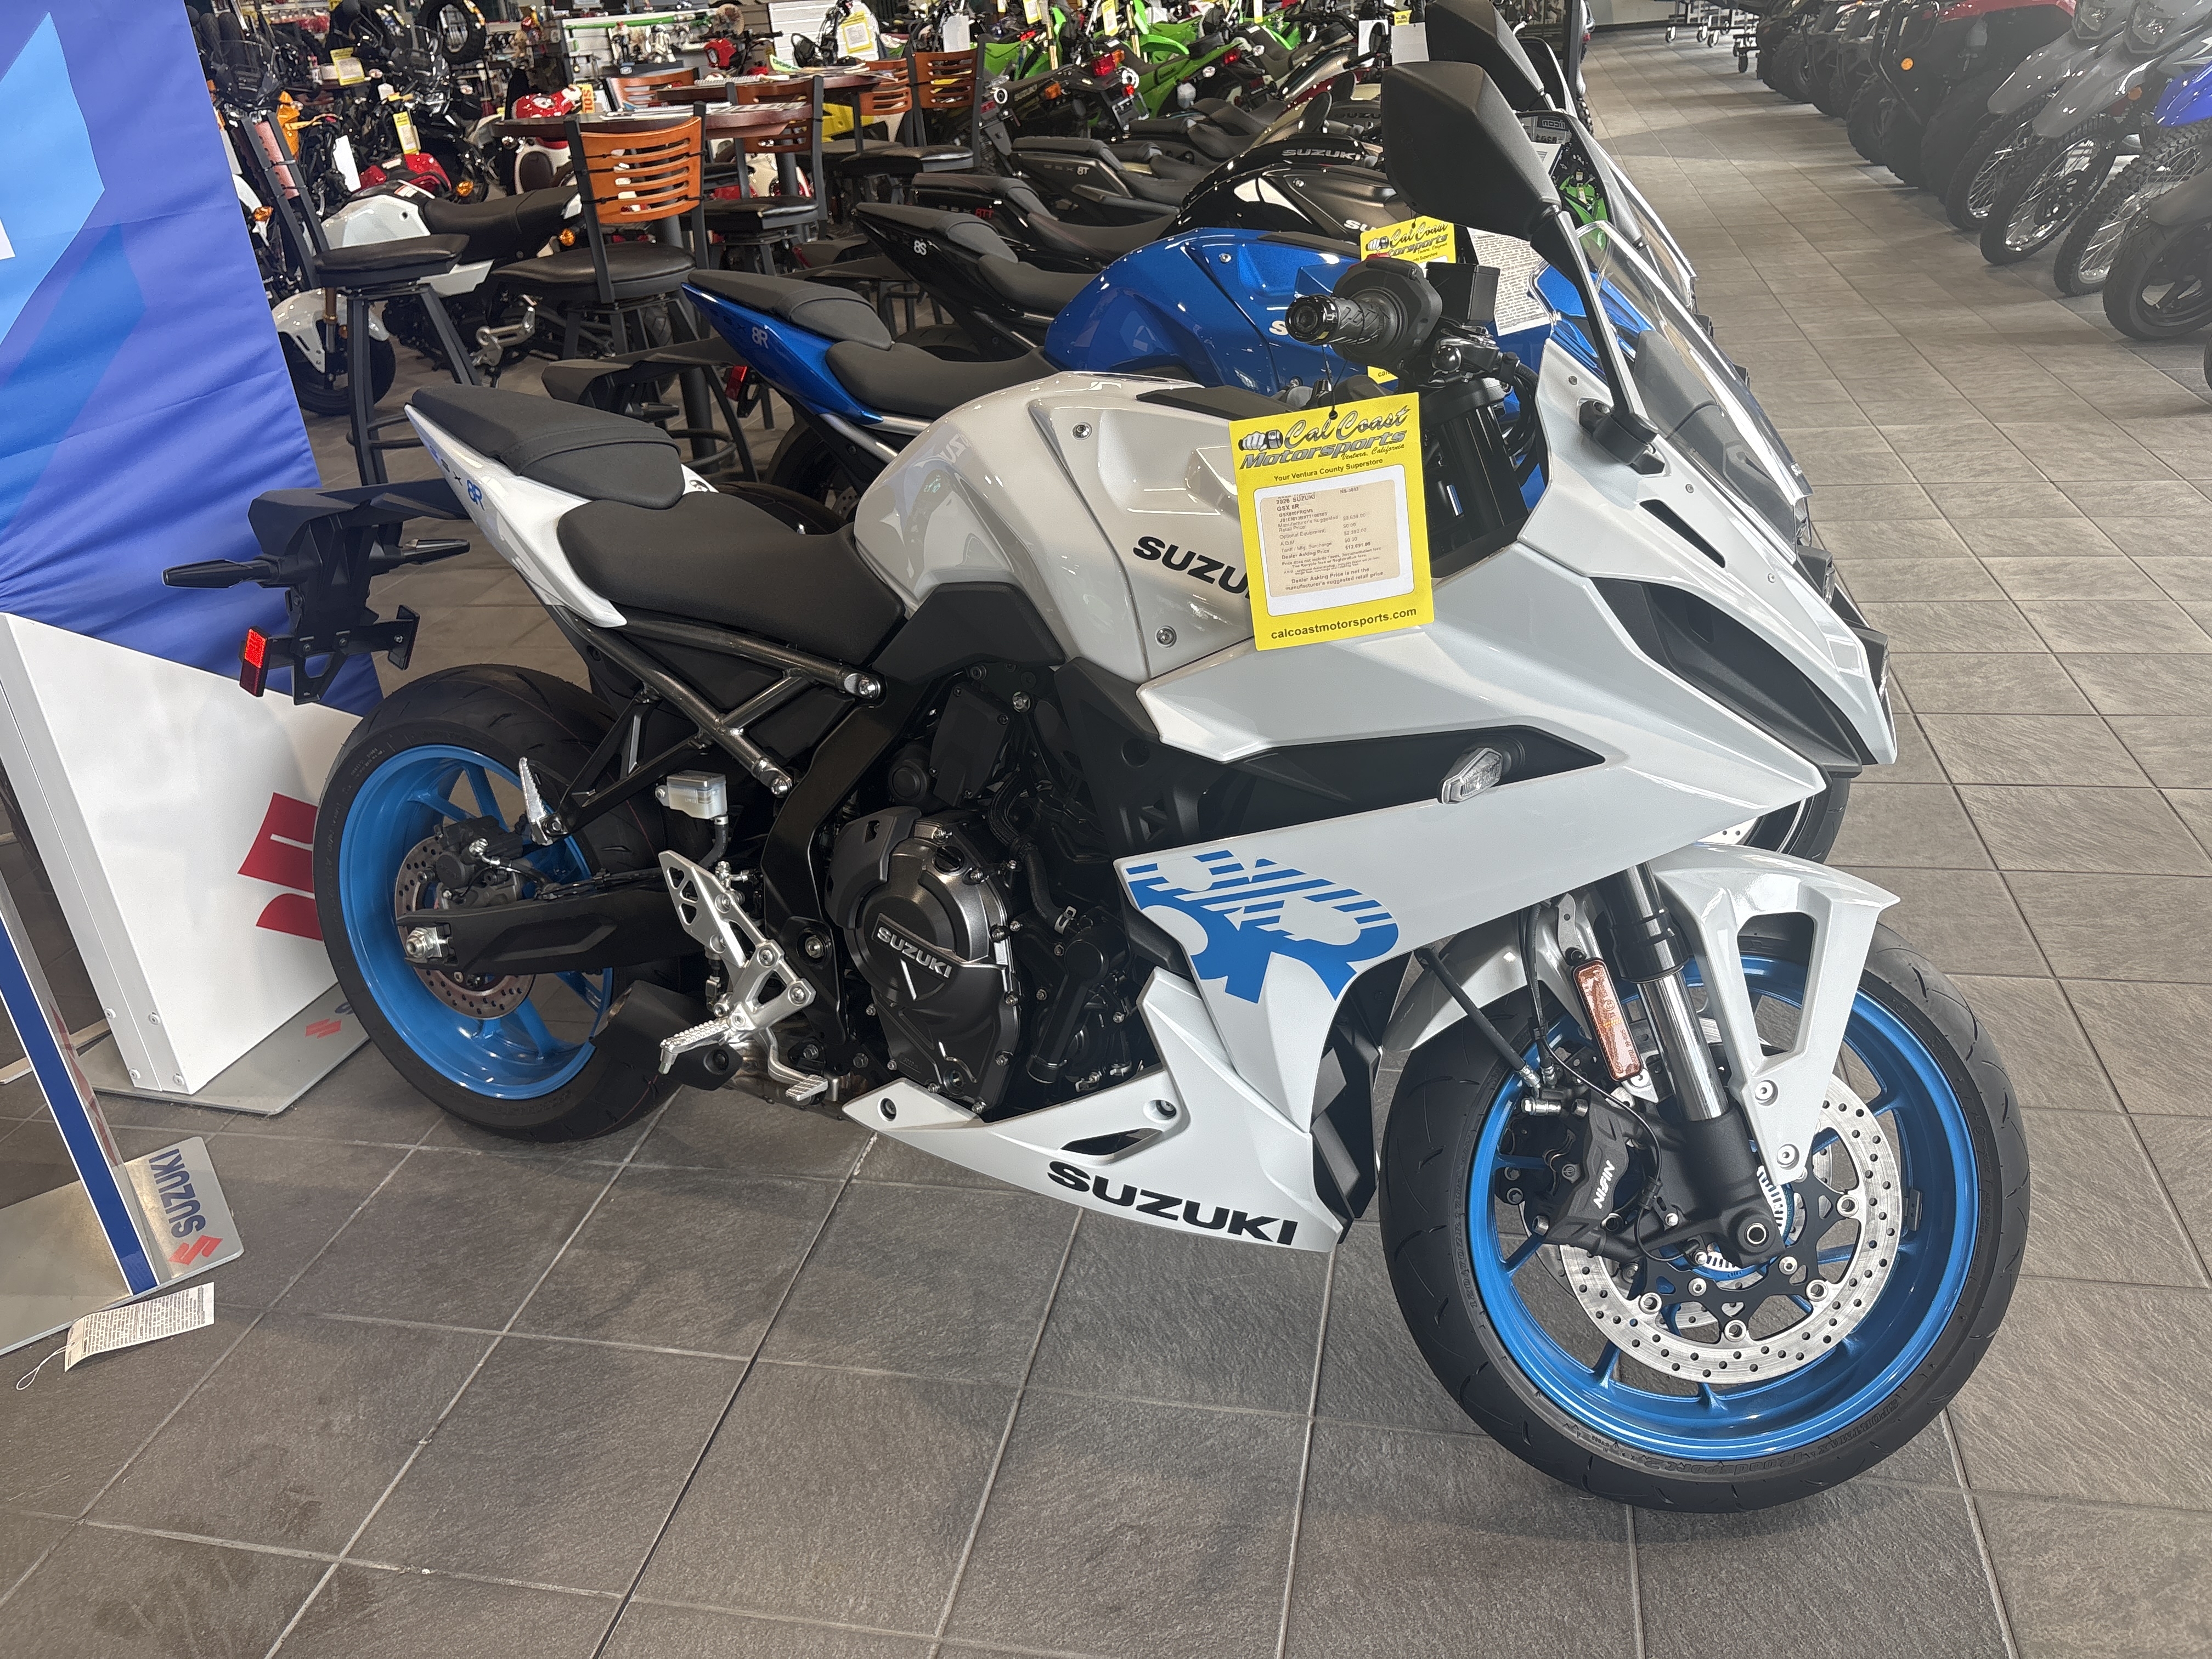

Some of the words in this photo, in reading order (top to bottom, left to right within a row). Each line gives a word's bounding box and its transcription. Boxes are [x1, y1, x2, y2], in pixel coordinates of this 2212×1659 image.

[583, 89, 593, 113] SOL
[1281, 148, 1361, 161] SUZUKI
[1077, 166, 1090, 176] 8T
[1389, 233, 1448, 257] torsports
[752, 326, 769, 349] 8R
[1284, 419, 1335, 449] Cal
[1335, 405, 1412, 441] Coast
[1239, 430, 1407, 470] Motorsports
[1291, 470, 1318, 479] Ventura
[1319, 465, 1344, 476] County
[1346, 459, 1384, 470] Superstore
[467, 479, 486, 511] 8R
[1293, 494, 1316, 503] SUZUKI
[1285, 582, 1325, 591] manufacturer's
[1326, 576, 1354, 585] suggested
[1271, 608, 1417, 639] calcoastmotorsports.com
[876, 925, 953, 979] SUZUKI
[149, 1148, 206, 1239] SUZUKI
[1593, 1159, 1615, 1209] NISSIN
[1048, 1160, 1299, 1246] SUZUKI
